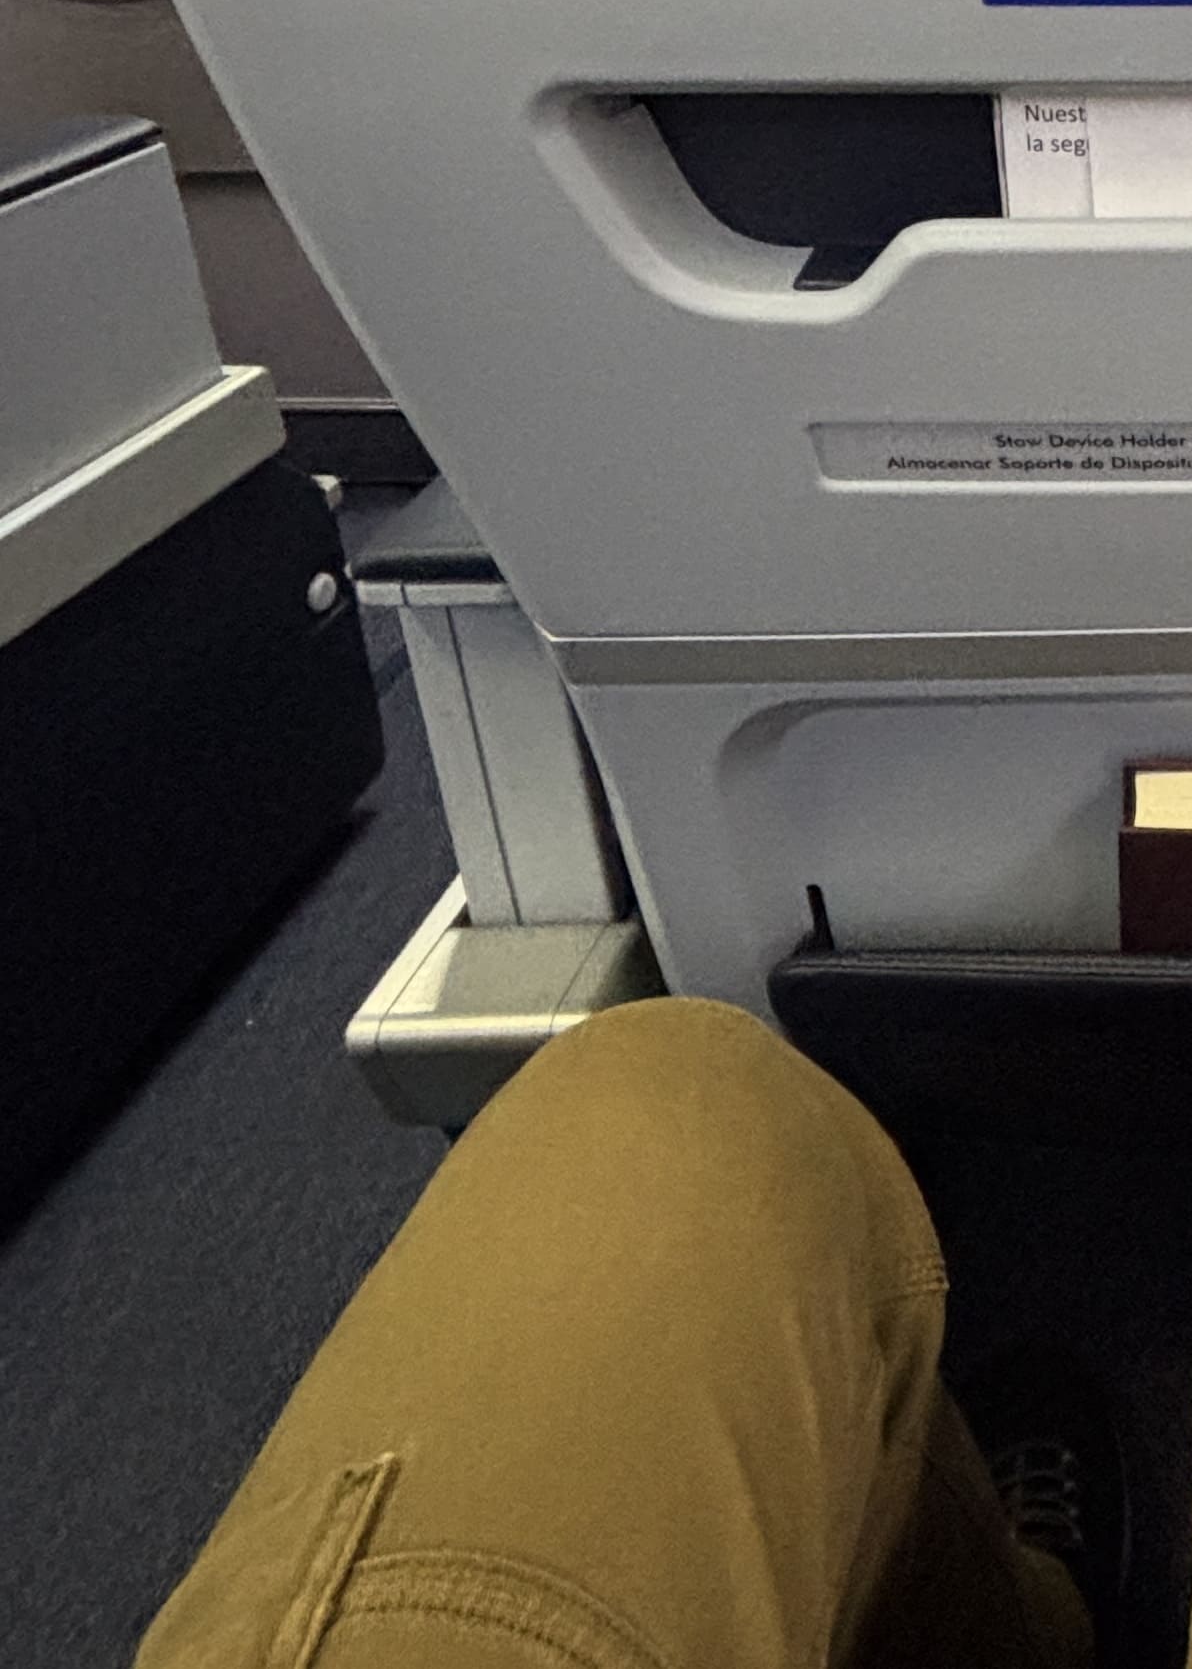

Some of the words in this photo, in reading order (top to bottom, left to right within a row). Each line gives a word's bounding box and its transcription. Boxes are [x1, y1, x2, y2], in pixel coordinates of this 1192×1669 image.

[1027, 132, 1043, 152] la
[1051, 138, 1089, 157] seg
[995, 434, 1041, 448] Stow
[1050, 434, 1114, 448] Device
[1121, 434, 1186, 447] Holder
[888, 457, 991, 470] Almacenar
[999, 457, 1073, 471] Soporte
[1081, 457, 1104, 470] de
